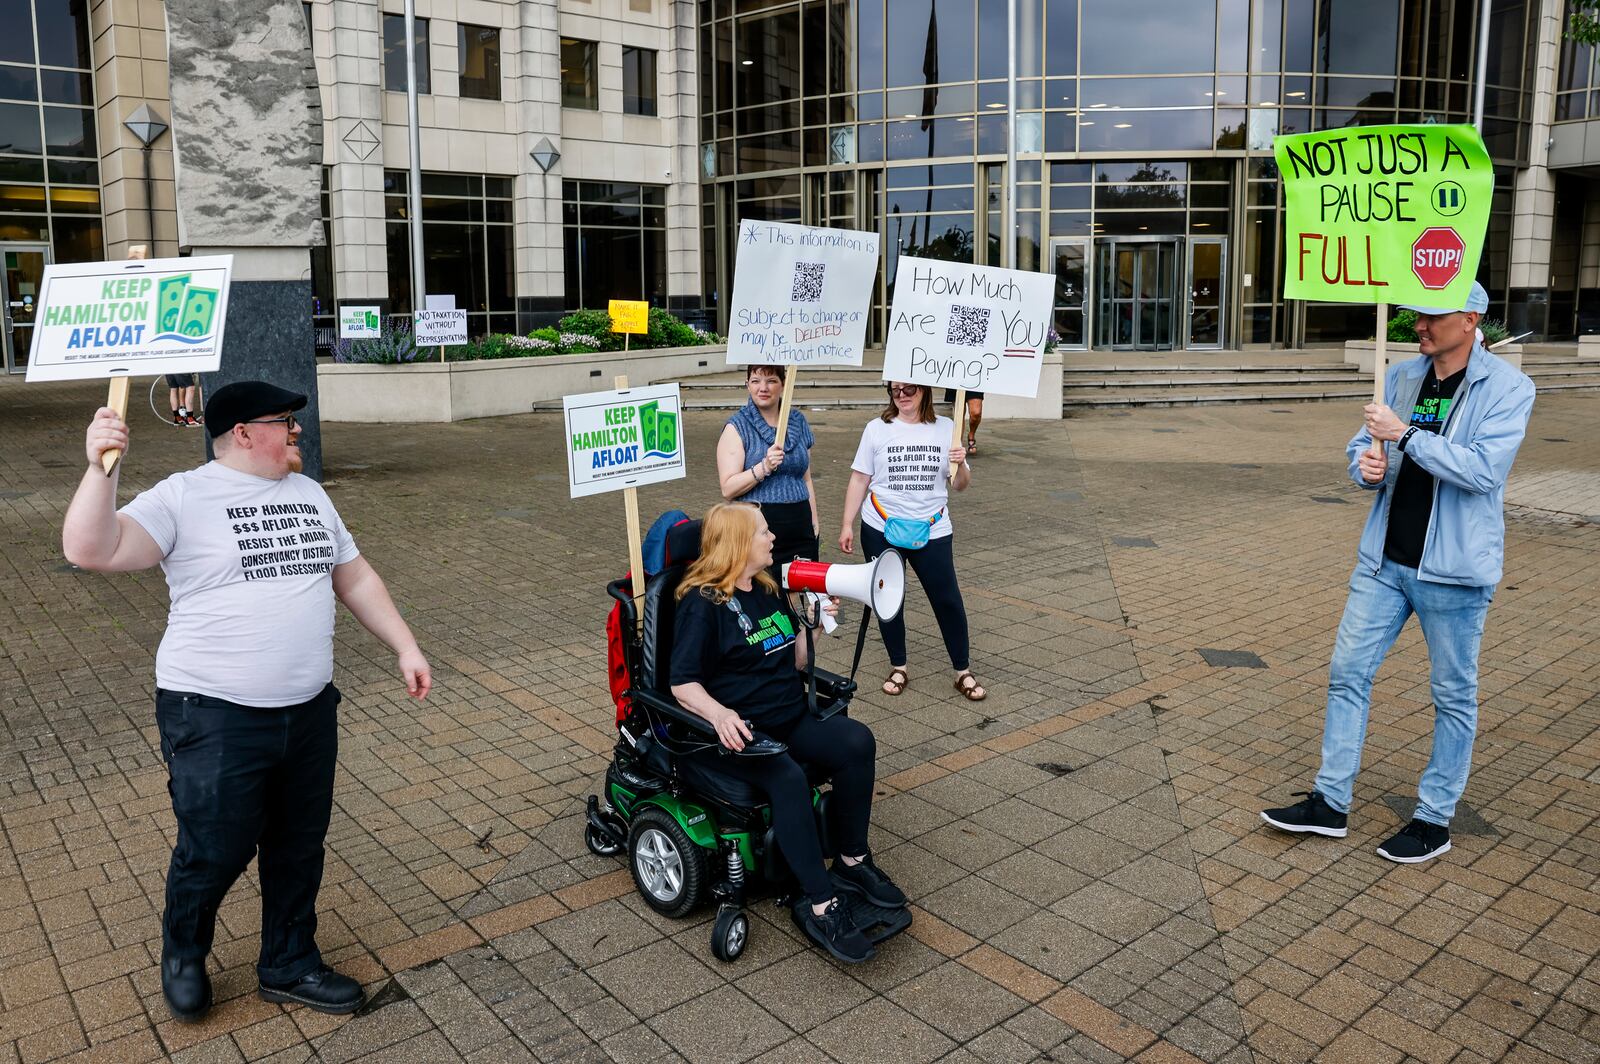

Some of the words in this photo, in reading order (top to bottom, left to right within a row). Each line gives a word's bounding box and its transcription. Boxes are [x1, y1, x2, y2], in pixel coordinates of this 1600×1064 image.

[1285, 137, 1348, 179] NOT
[1357, 133, 1427, 175] JUST
[1440, 136, 1470, 172] A
[1321, 181, 1416, 223] PAUSE
[766, 226, 794, 246] This
[799, 229, 861, 251] information
[865, 240, 875, 253] is
[1299, 232, 1389, 286] FULL
[1415, 248, 1461, 268] STOP!
[101, 277, 152, 300] KEEP
[913, 267, 965, 296] How
[970, 273, 1022, 303] Much
[44, 301, 150, 327] HAMILTON
[418, 311, 431, 320] NO
[431, 311, 465, 320] TAXATION
[425, 320, 457, 330] WITHOUT
[737, 307, 794, 329] Subject
[796, 308, 810, 324] to
[812, 308, 848, 329] change
[849, 311, 864, 322] or
[894, 311, 936, 335] Are
[66, 324, 146, 350] AFLOAT
[740, 331, 768, 354] may
[772, 330, 789, 347] be
[794, 325, 842, 344] DELETED
[817, 341, 854, 359] notice
[910, 346, 1000, 389] Paying?
[604, 405, 636, 426] KEEP
[572, 425, 638, 451] HAMILTON
[887, 445, 905, 453] KEEP
[906, 445, 941, 453] HAMILTON
[592, 445, 639, 469] AFLOAT
[887, 455, 902, 463] $$$
[903, 454, 926, 462] AFLOAT
[927, 455, 941, 463] $$$
[888, 465, 908, 473] RESIST
[921, 465, 940, 473] MIAMI
[888, 474, 920, 482] CONSERVANCY
[226, 506, 258, 520] KEEP
[261, 503, 319, 516] HAMILTON
[232, 522, 260, 535] $$$
[262, 517, 301, 532] AFLOAT
[237, 538, 275, 551] RESIST
[276, 535, 298, 547] THE
[299, 531, 331, 544] MIAMI
[241, 549, 300, 568] CONSERVANCY
[302, 546, 334, 560] DISTRICT
[244, 566, 278, 581] FLOOD
[280, 562, 334, 577] ASSESSMENT
